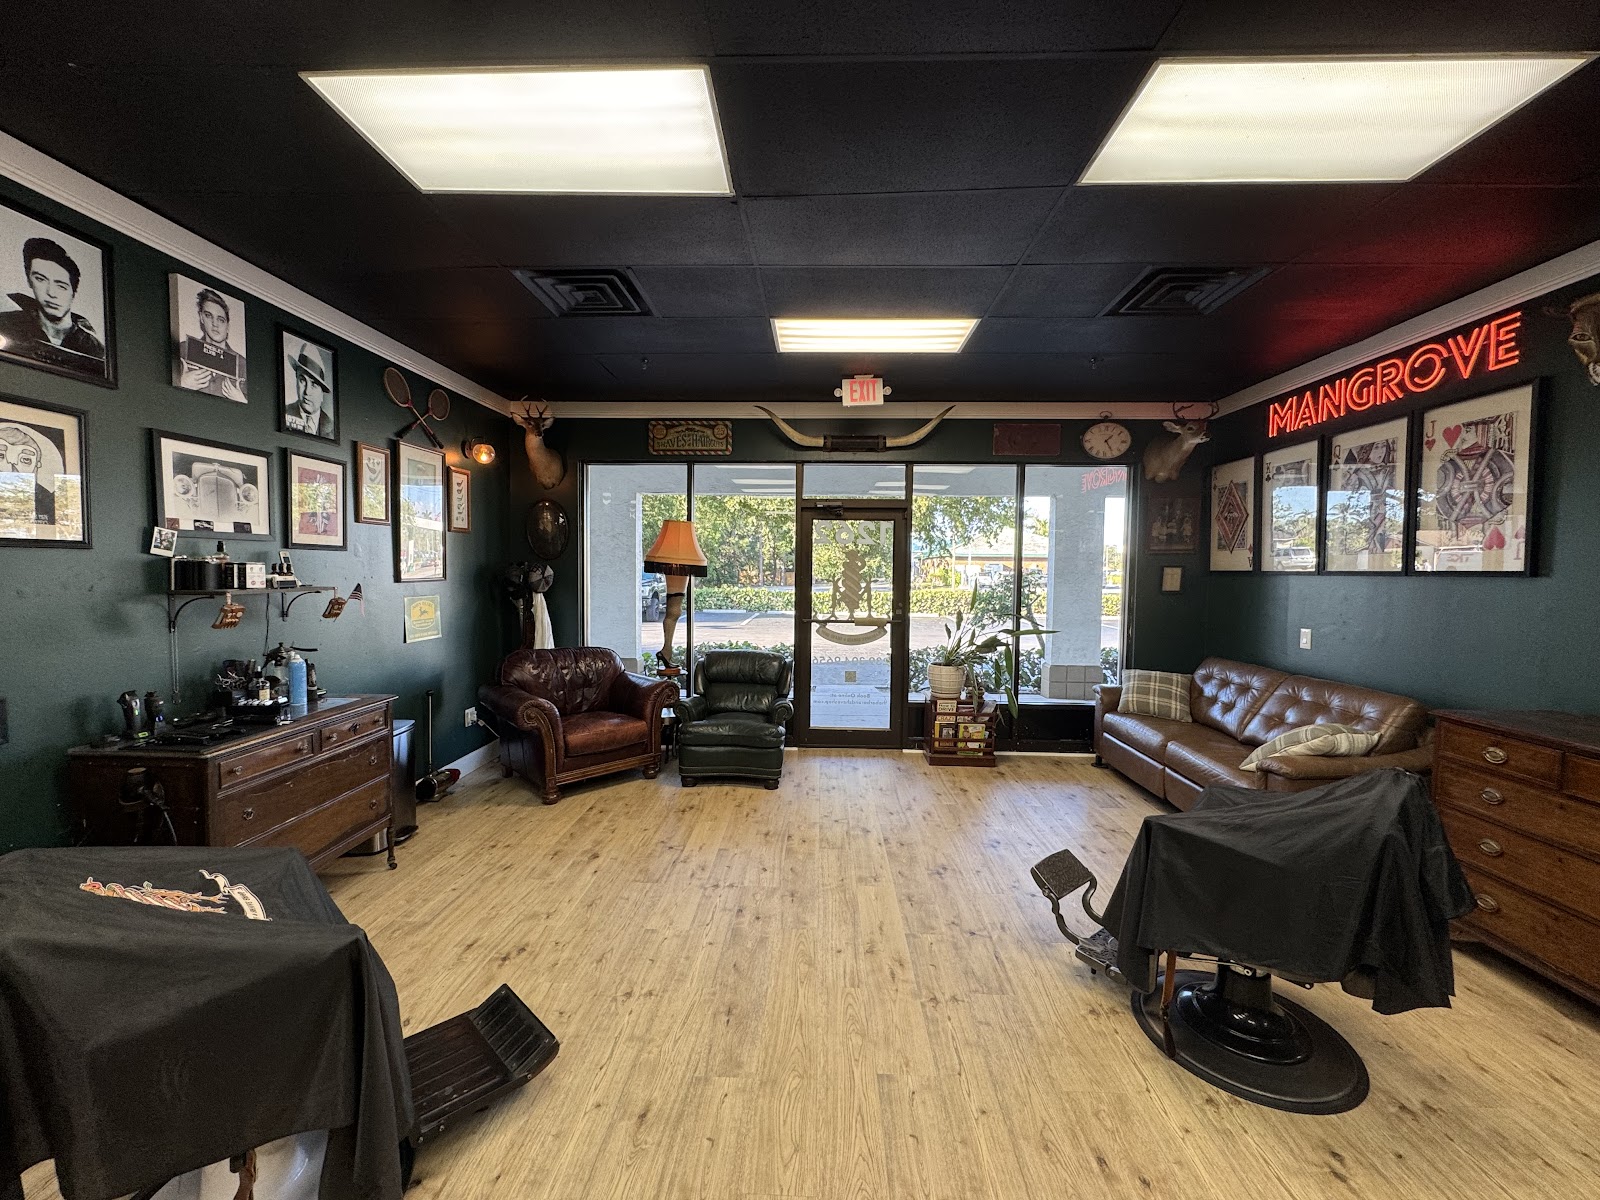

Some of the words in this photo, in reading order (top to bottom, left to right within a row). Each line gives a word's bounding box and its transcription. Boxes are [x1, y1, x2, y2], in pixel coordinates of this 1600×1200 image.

[203, 343, 224, 354] PRESLEY
[1268, 311, 1521, 438] MANGROVE
[850, 380, 878, 403] EXIT
[1425, 420, 1437, 440] J
[656, 432, 687, 449] SHAVES
[691, 432, 724, 448] HAIRCUTS
[1333, 445, 1341, 460] Q
[1265, 462, 1272, 475] K
